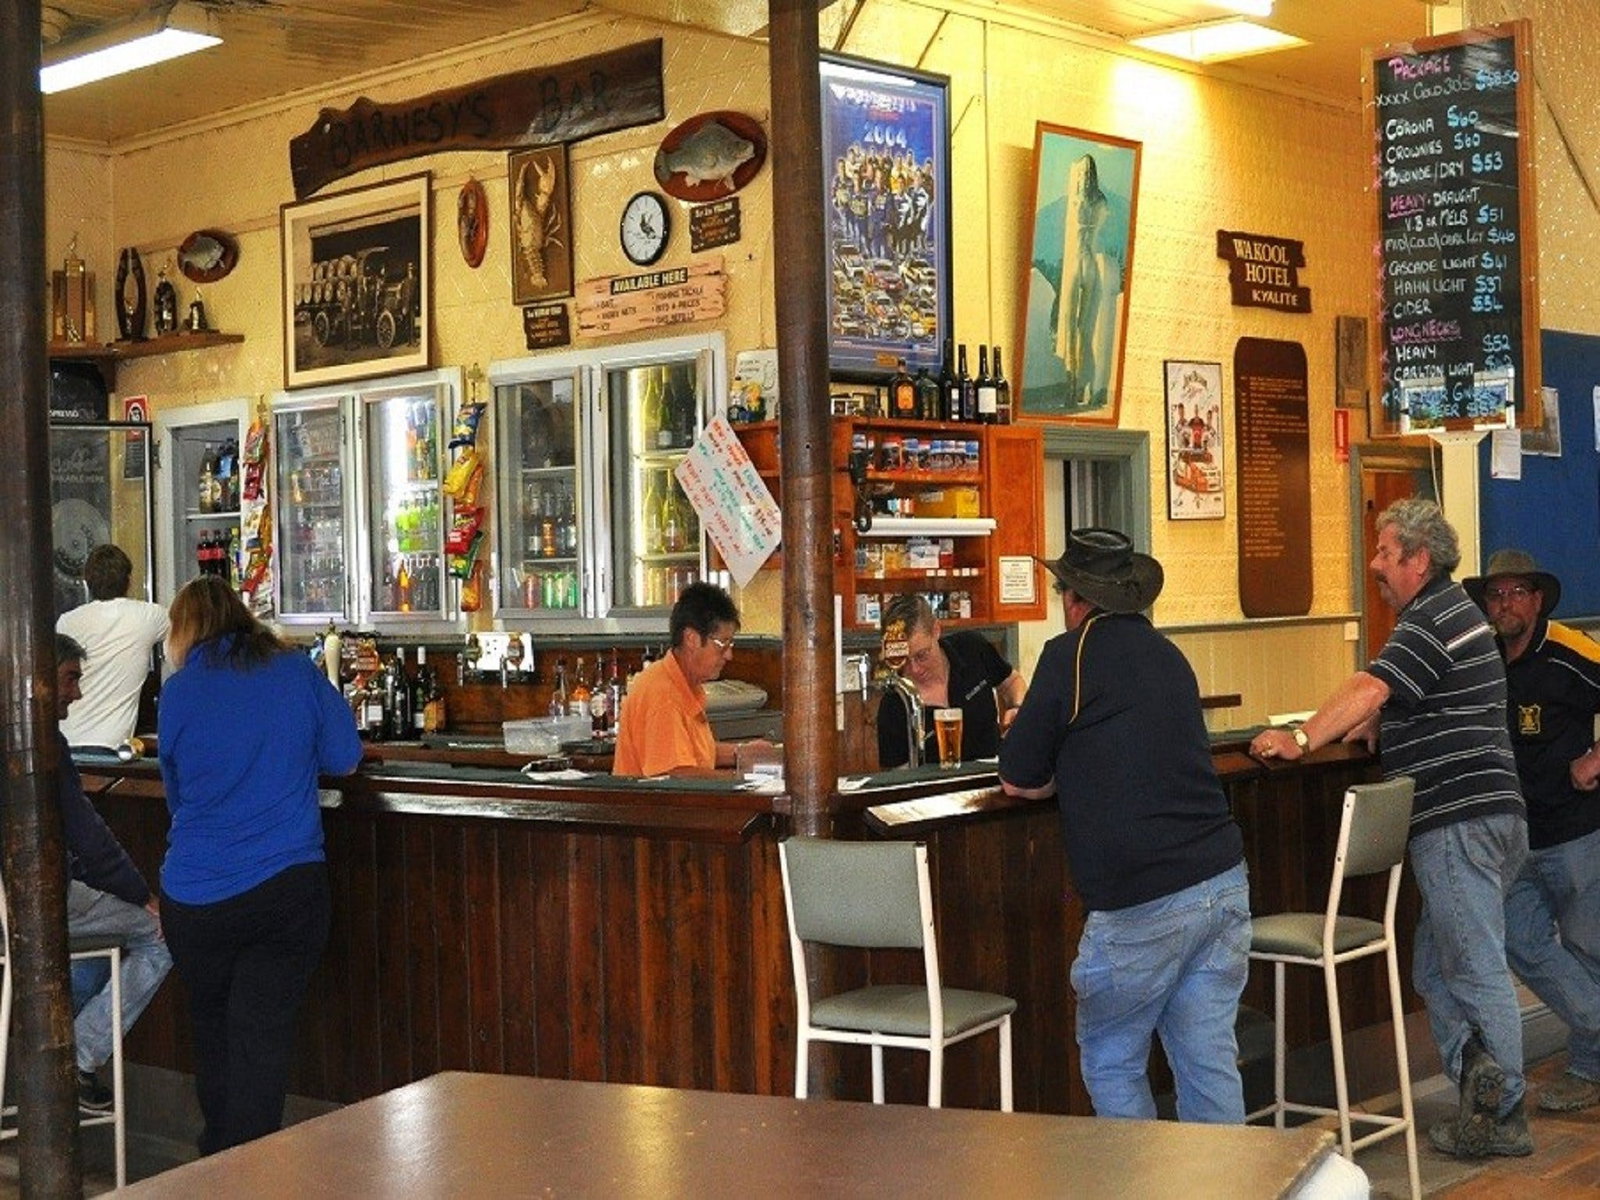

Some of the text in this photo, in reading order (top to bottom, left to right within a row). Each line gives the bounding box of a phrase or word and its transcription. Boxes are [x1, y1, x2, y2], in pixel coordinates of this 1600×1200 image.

[539, 70, 610, 130] BAR
[1386, 117, 1434, 140] CORONA
[1233, 239, 1290, 266] WAKOOL
[1245, 263, 1291, 287] HOTEL
[1389, 259, 1438, 276] CASCADE
[1443, 255, 1478, 270] LIGHT
[613, 270, 687, 293] AVAILABLE HERE
[1394, 280, 1430, 296] HAHN
[1252, 289, 1298, 306] KYALITE
[1393, 299, 1432, 319] CIDER
[1396, 345, 1437, 362] HEAVY
